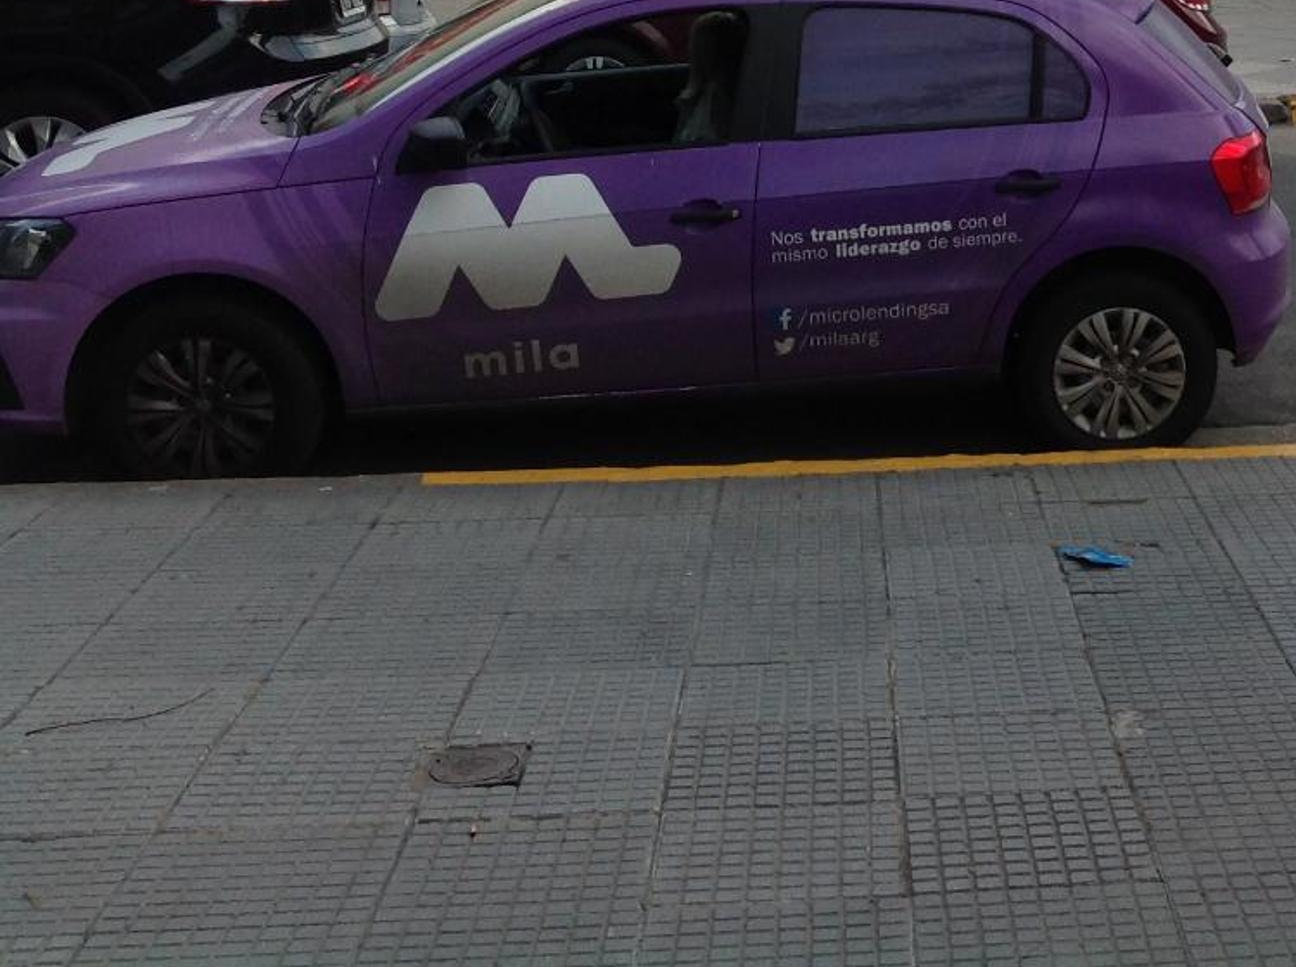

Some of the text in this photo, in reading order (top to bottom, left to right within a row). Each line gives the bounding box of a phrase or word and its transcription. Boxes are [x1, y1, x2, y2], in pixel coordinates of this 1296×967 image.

[771, 212, 1007, 246] Nos transformamos con el
[771, 228, 1024, 264] mismo liderazgo de siempre.
[463, 339, 580, 379] mila
